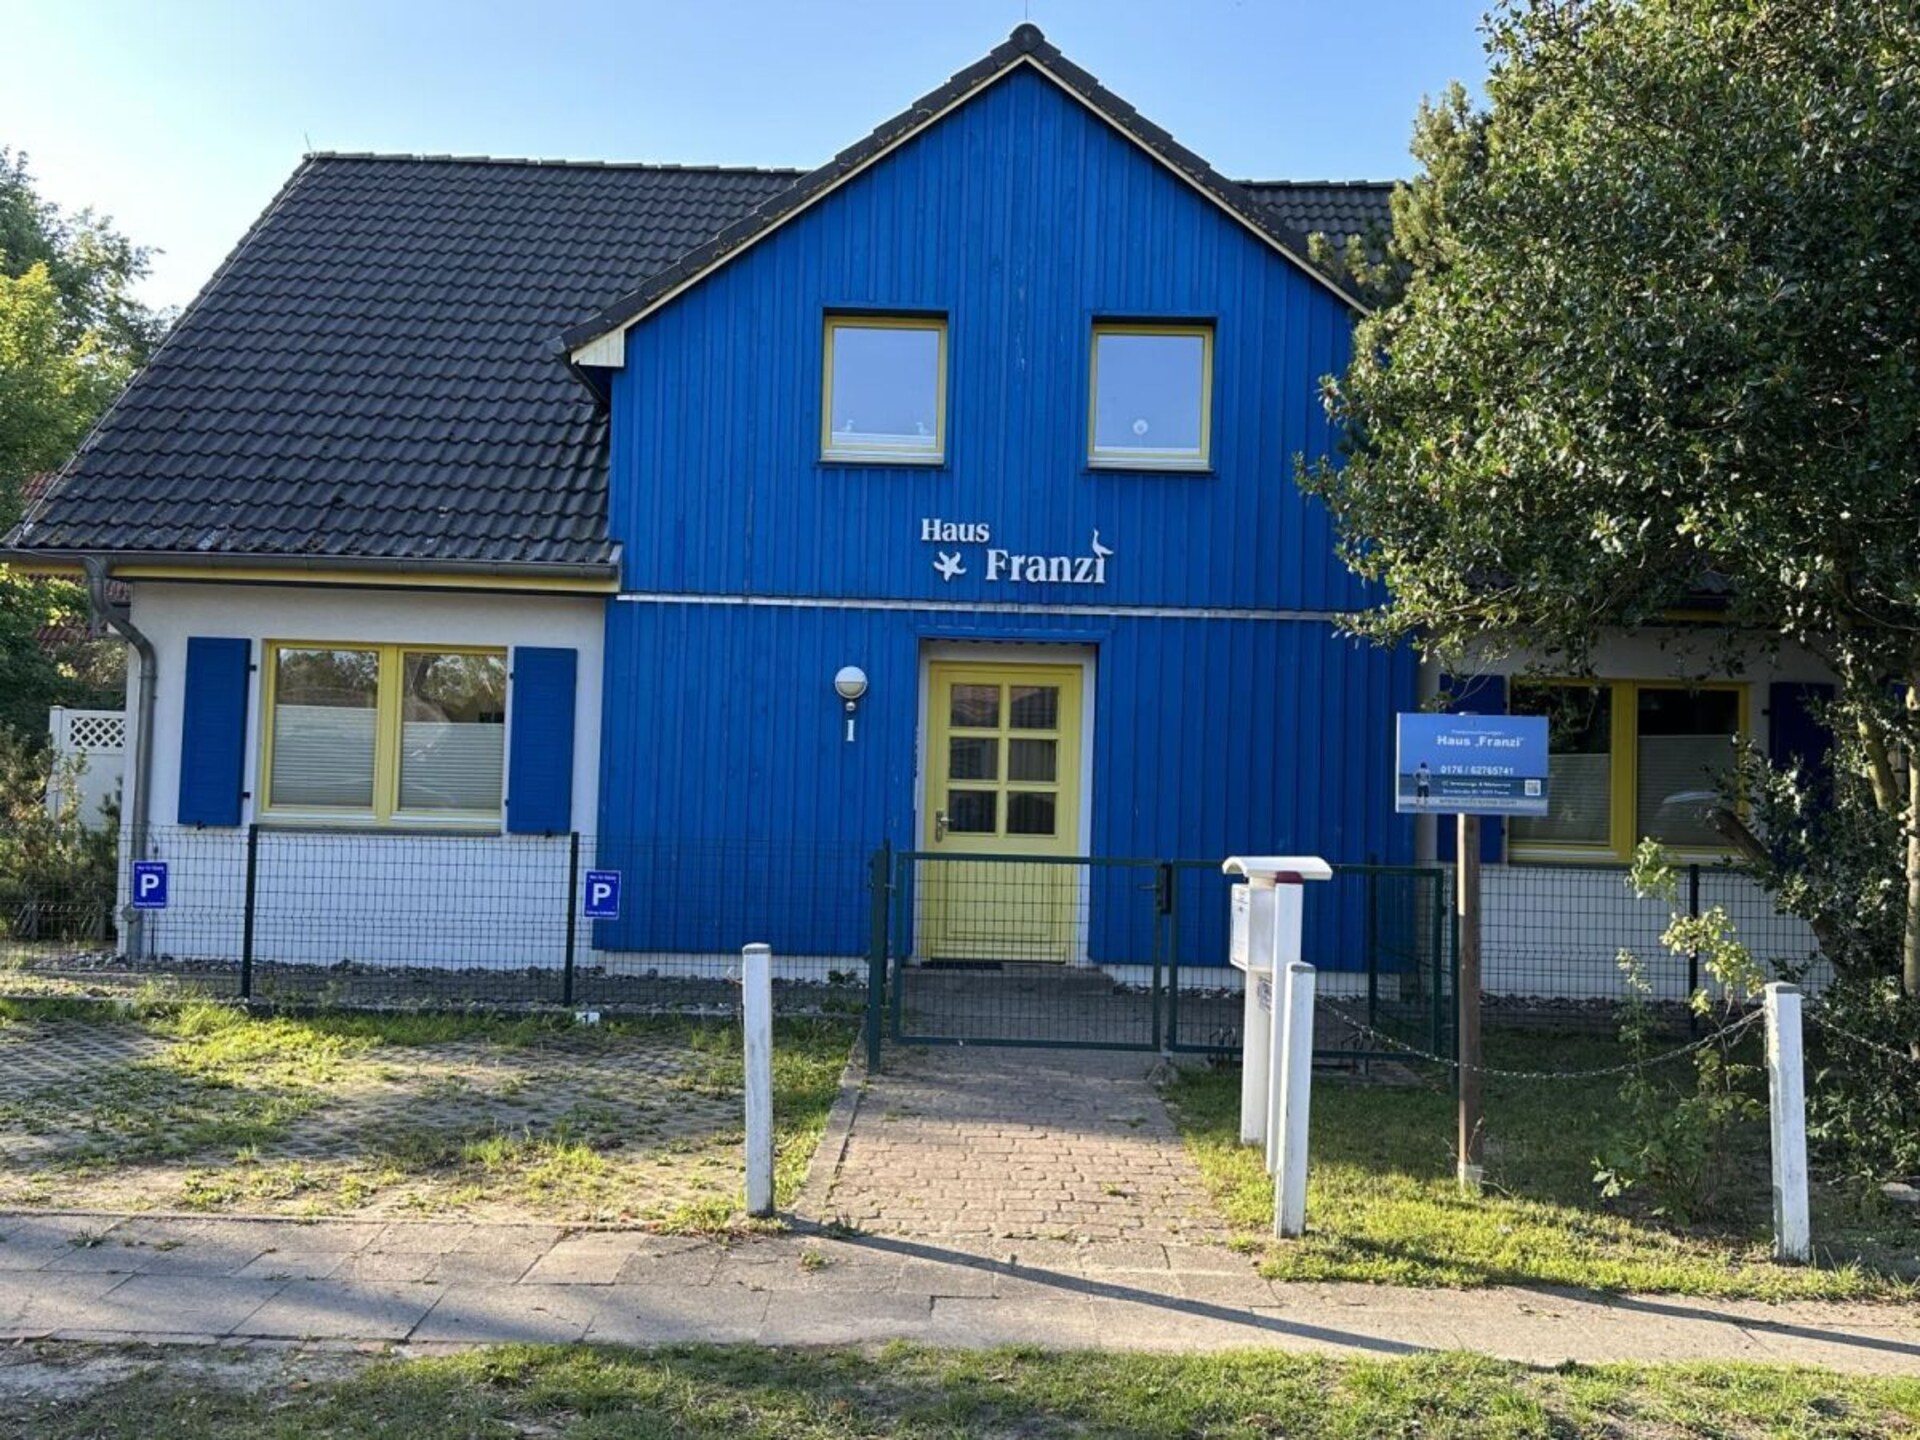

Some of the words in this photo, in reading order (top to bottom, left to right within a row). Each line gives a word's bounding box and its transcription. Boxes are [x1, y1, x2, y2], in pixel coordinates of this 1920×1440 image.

[921, 518, 990, 542] Haus
[985, 548, 1105, 584] Franzi
[846, 719, 855, 742] 1
[1437, 735, 1471, 746] Haus
[1440, 765, 1463, 775] 0176
[140, 874, 160, 898] P
[592, 882, 612, 907] P
